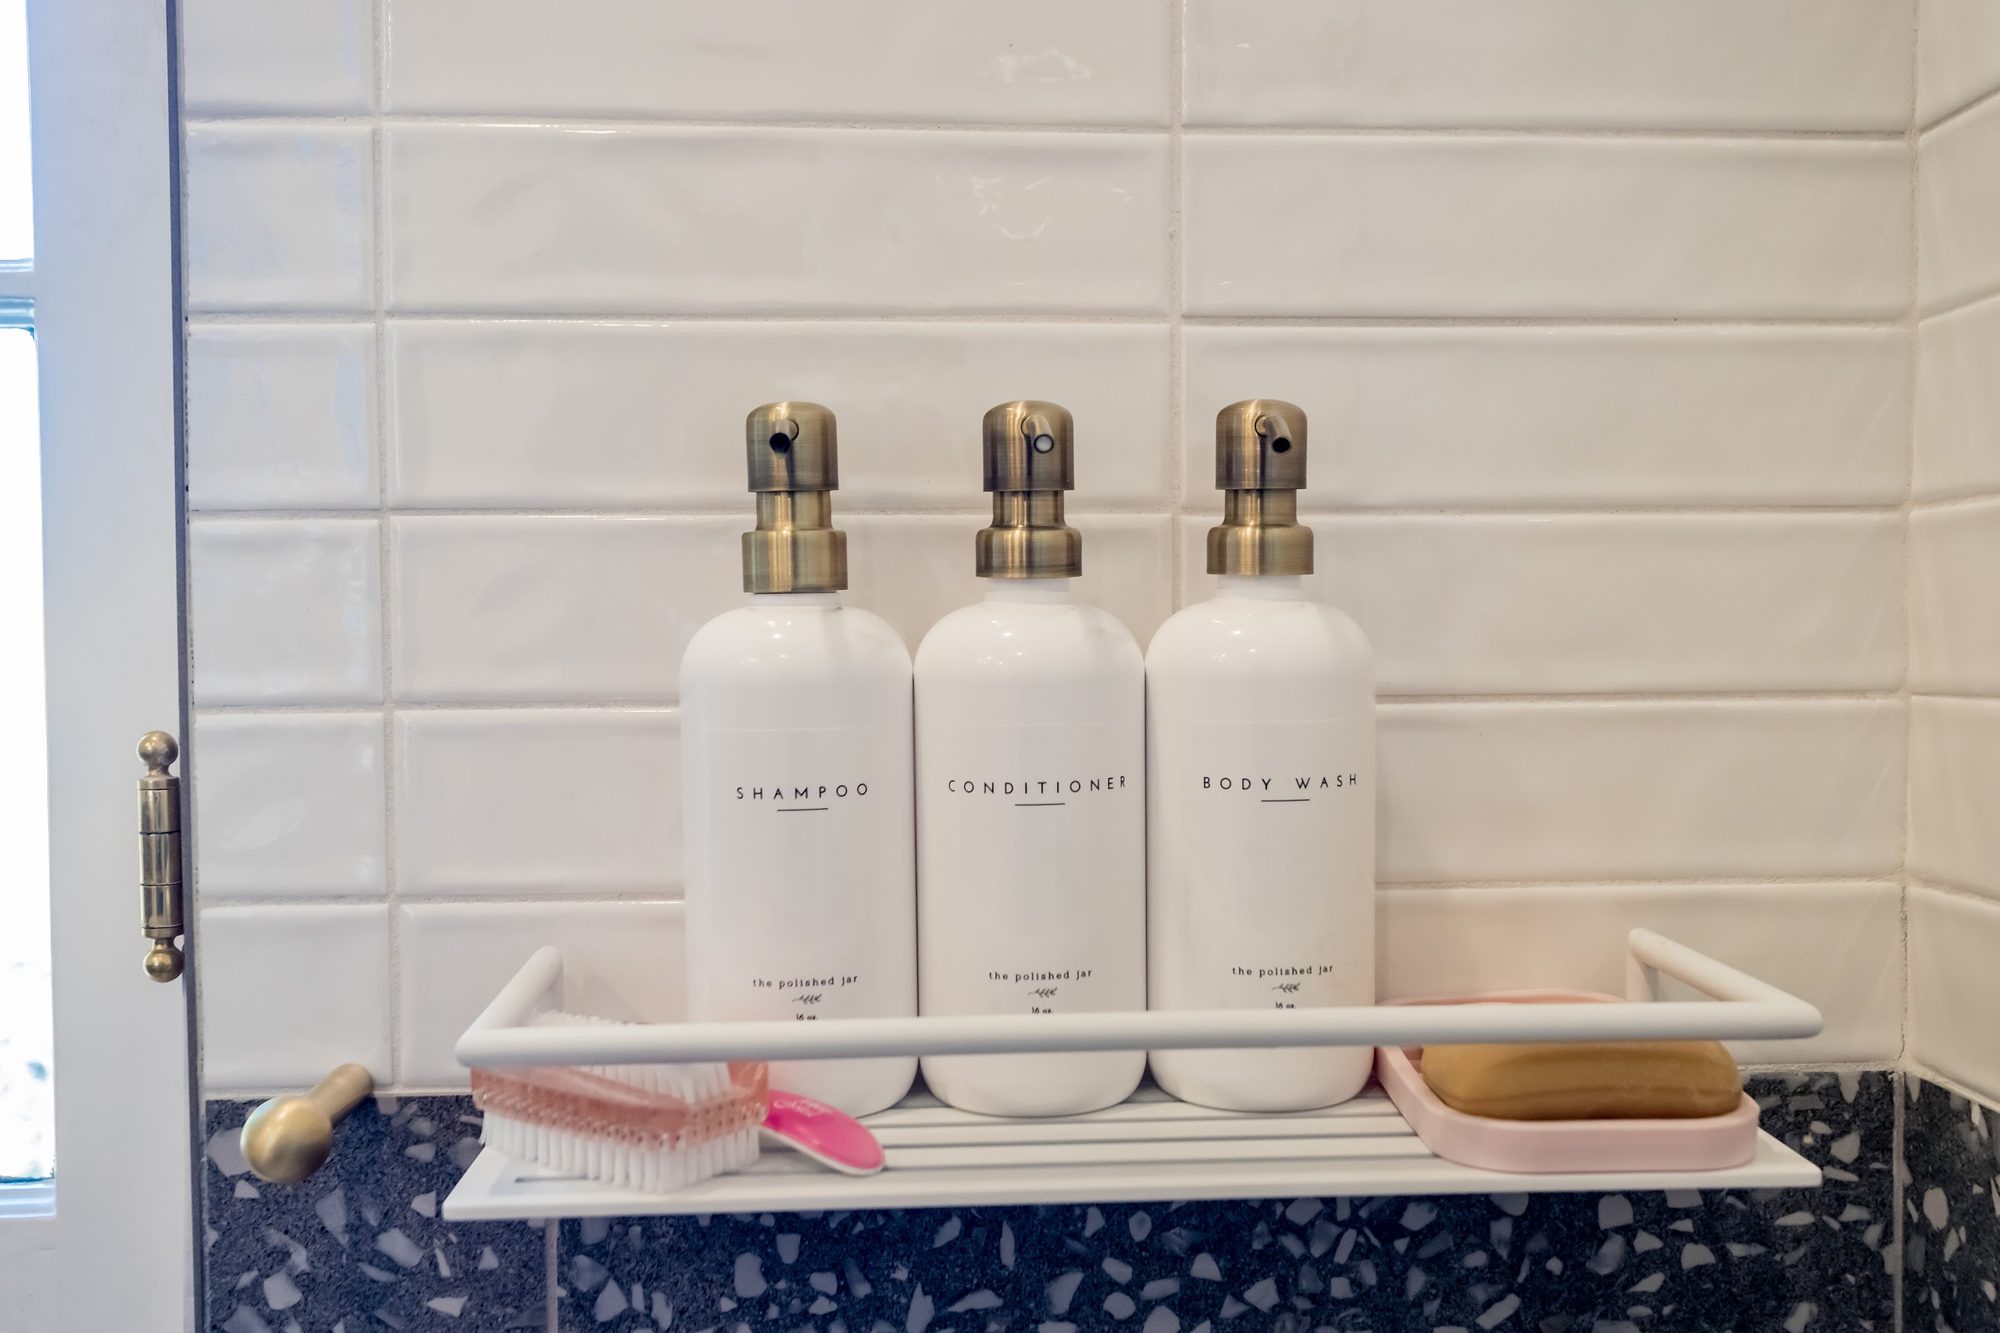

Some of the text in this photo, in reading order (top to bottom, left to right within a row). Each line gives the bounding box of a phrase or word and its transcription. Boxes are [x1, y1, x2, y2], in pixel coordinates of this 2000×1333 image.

[948, 775, 1126, 794] CONDITIONER
[1203, 773, 1357, 791] BODY WASH
[736, 783, 868, 800] SHAMPOO
[988, 969, 1093, 983] the polished jar
[1232, 964, 1333, 978] the polished jar
[752, 974, 859, 990] the polished jar
[1031, 1006, 1041, 1015] 16
[1275, 1001, 1284, 1010] 16
[796, 1013, 805, 1021] 16
